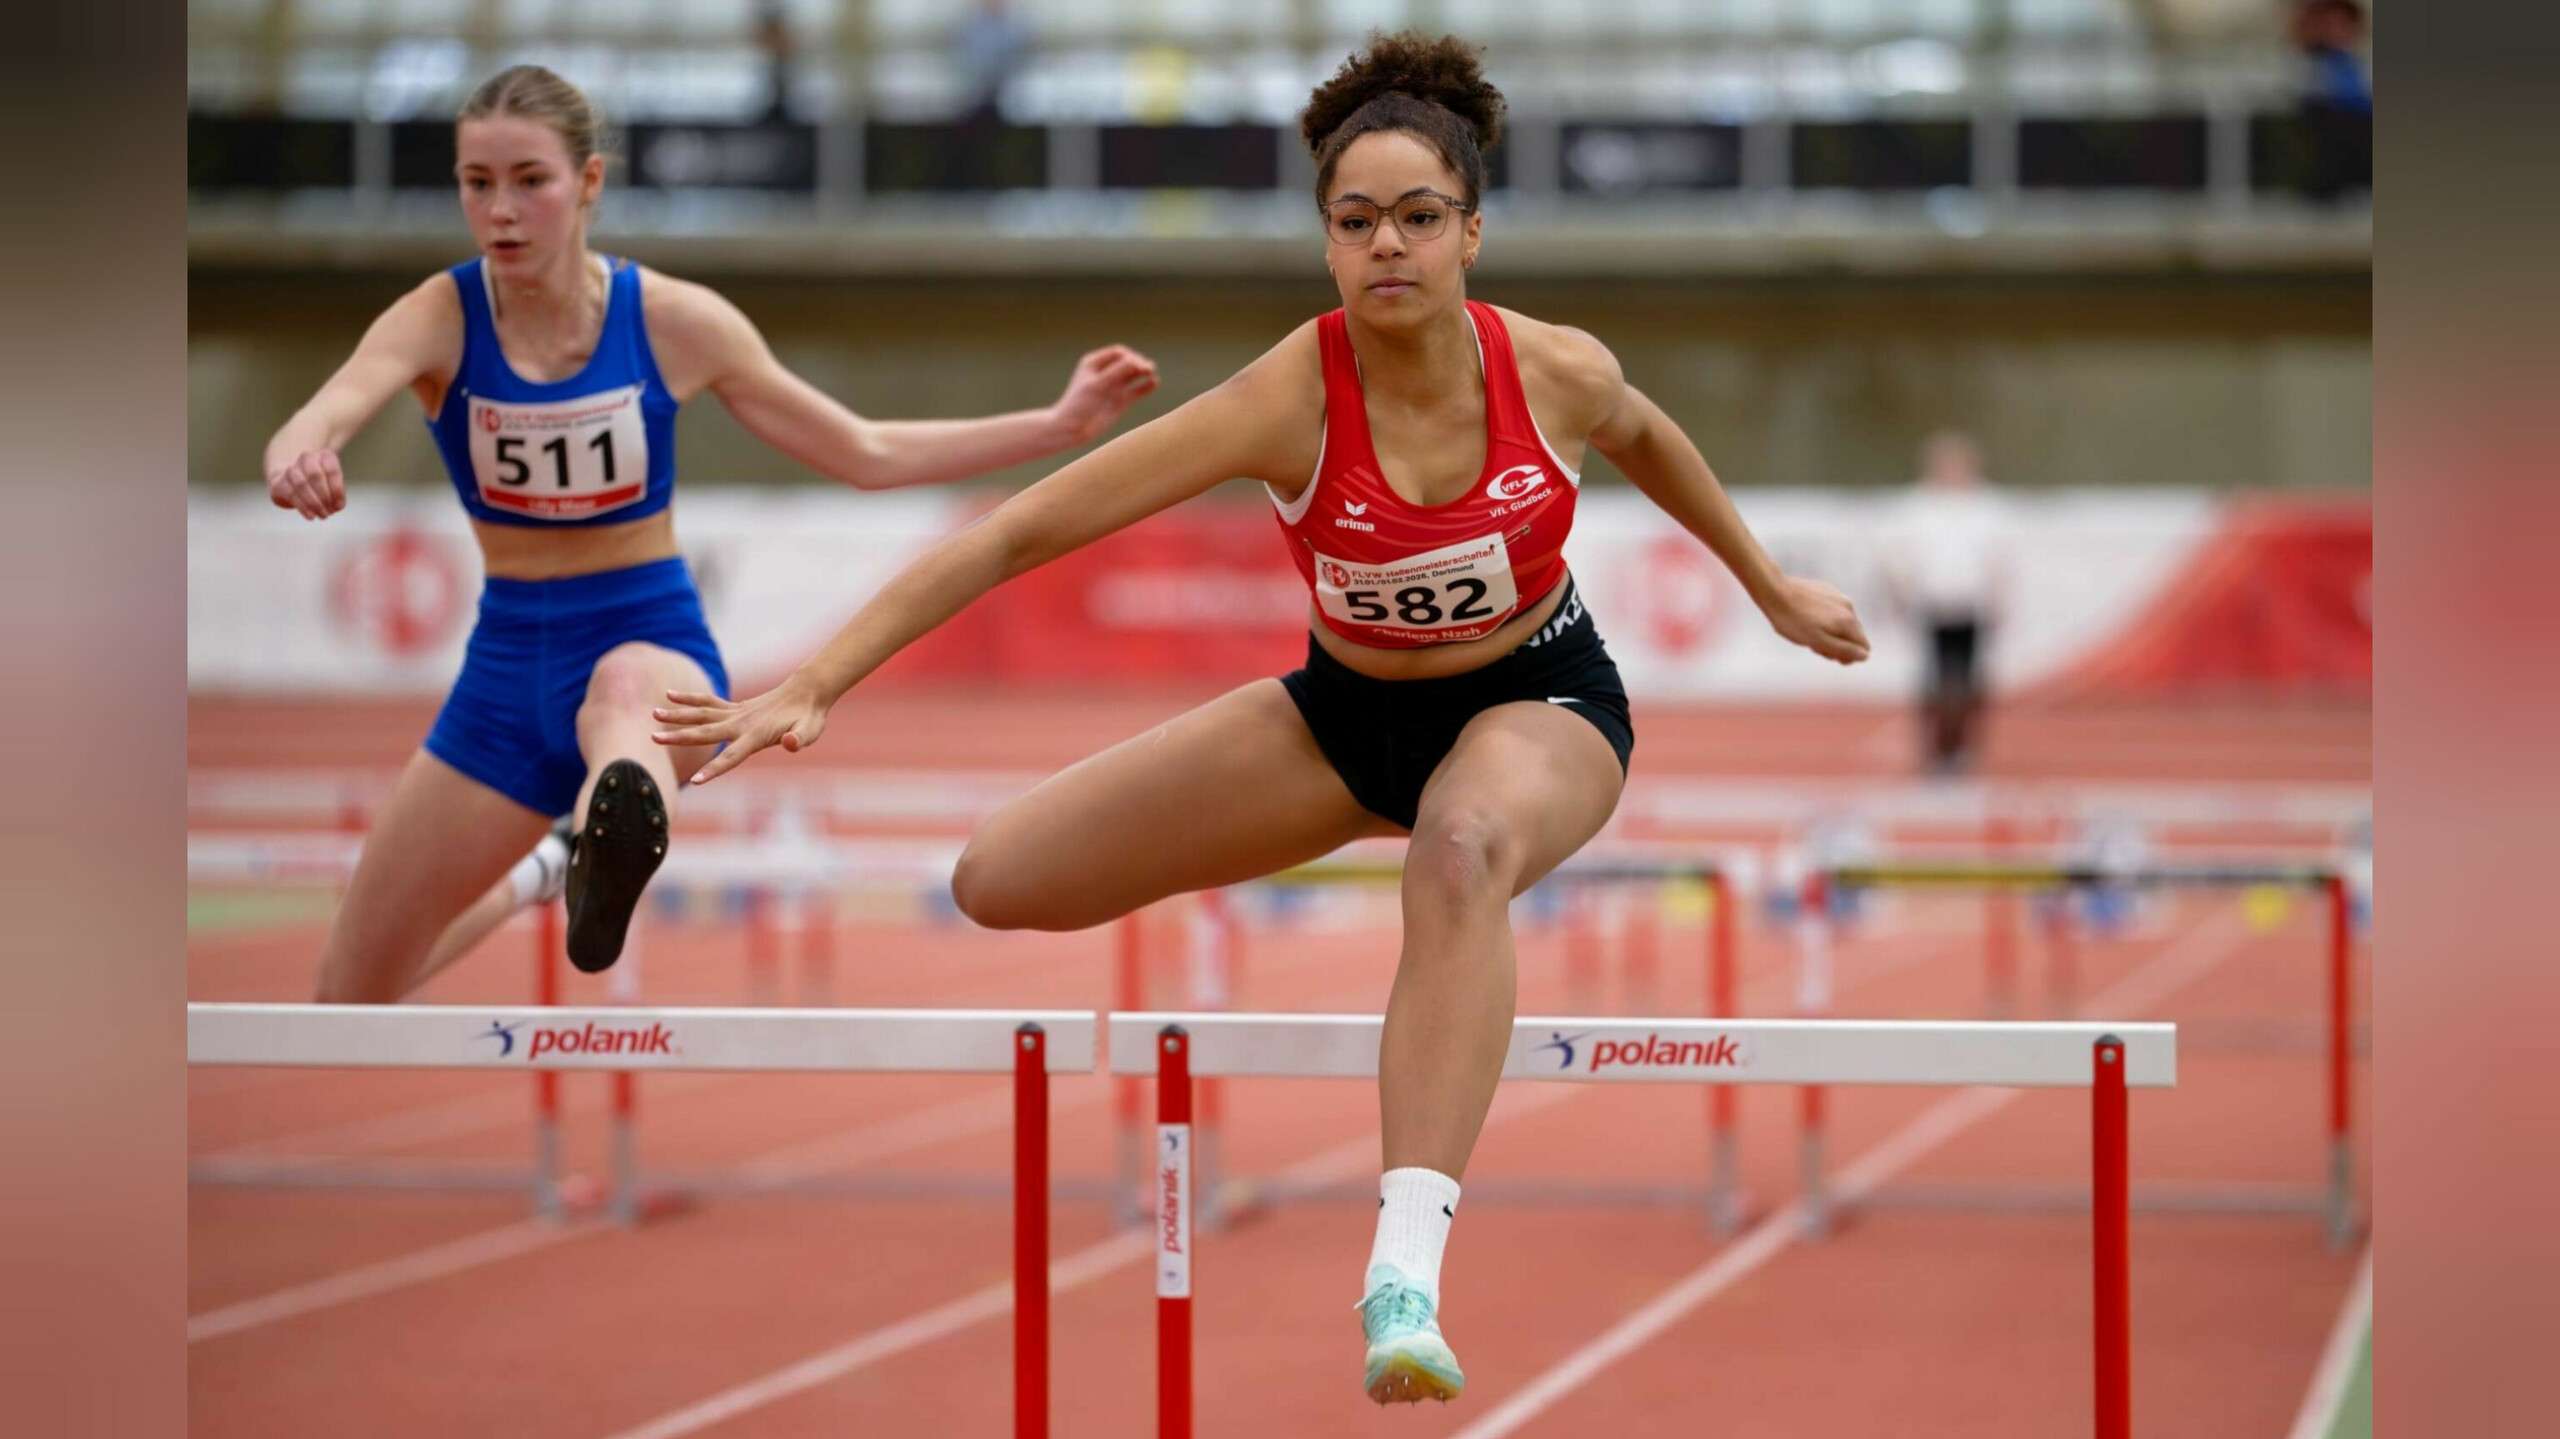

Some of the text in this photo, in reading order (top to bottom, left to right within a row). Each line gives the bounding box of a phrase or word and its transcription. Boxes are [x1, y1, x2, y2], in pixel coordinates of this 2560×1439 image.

[496, 430, 616, 488] 511
[1510, 487, 1553, 511] Gladbeck
[1335, 518, 1376, 532] erima
[1432, 563, 1475, 577] Dortmund
[1345, 577, 1494, 625] 582
[528, 1020, 673, 1061] polanik
[1590, 1032, 1741, 1073] polanik
[1161, 1168, 1183, 1253] polanik
